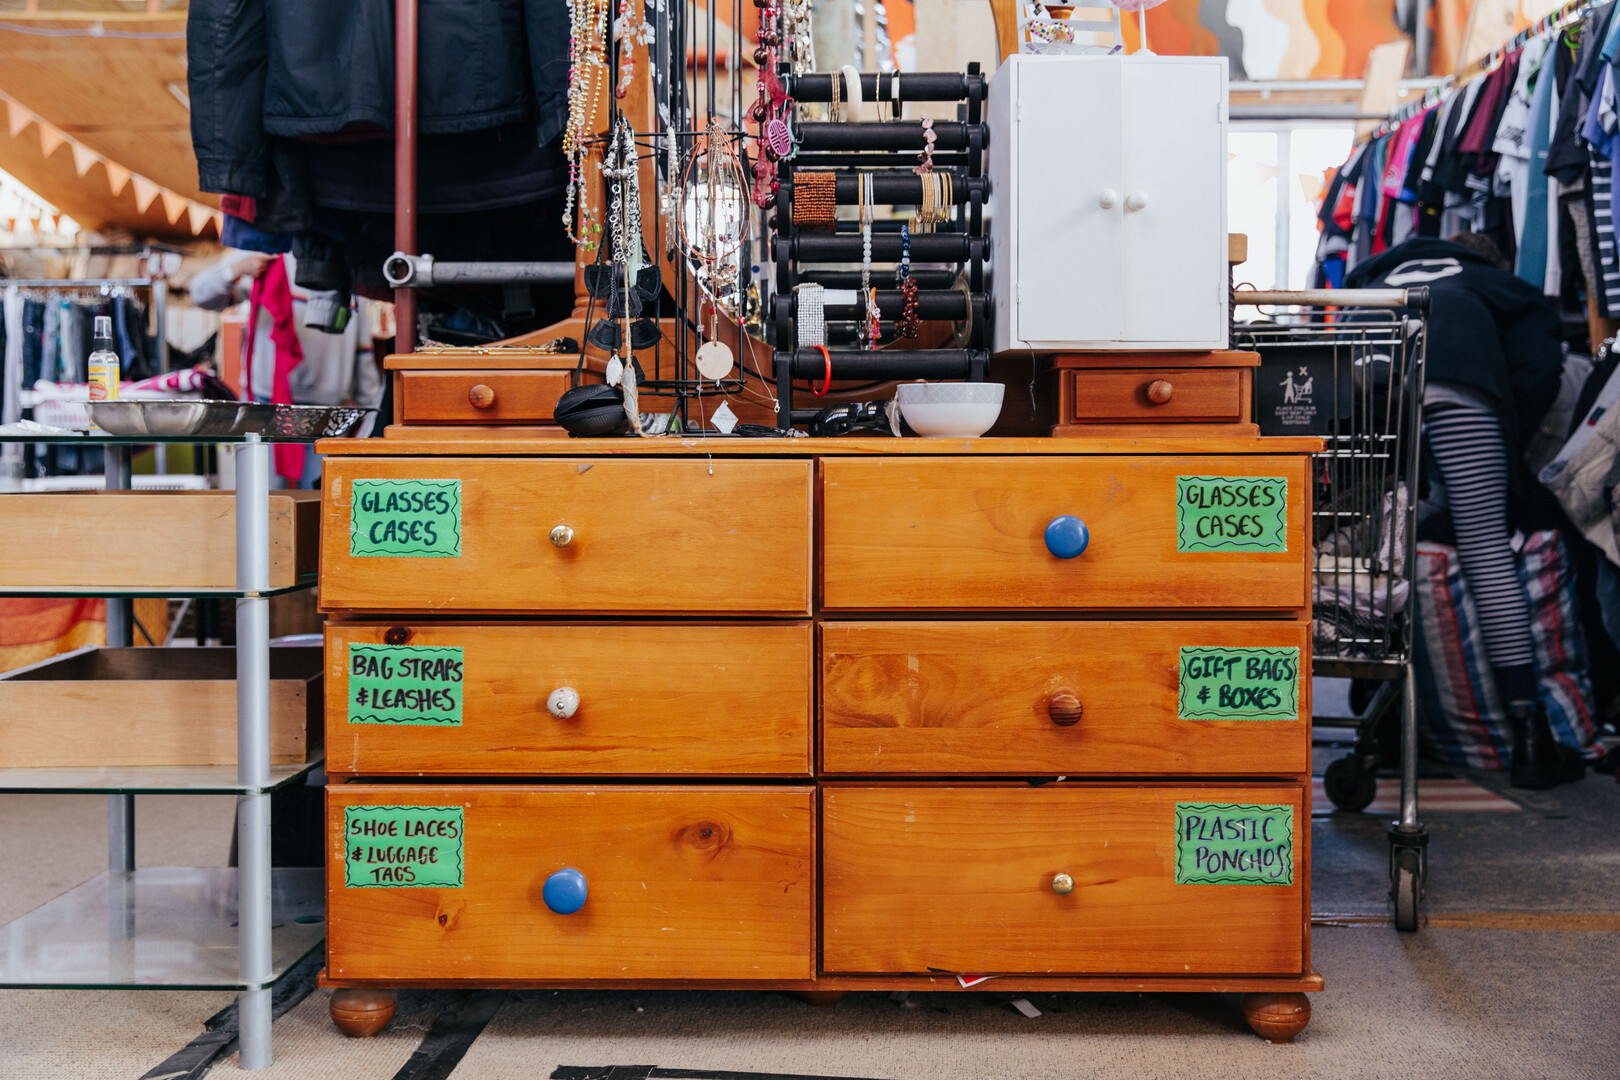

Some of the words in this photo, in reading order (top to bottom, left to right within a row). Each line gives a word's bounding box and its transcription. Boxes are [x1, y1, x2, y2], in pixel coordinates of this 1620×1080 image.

[361, 491, 450, 515] GLASSES
[1186, 485, 1275, 509] GLASSES
[369, 520, 437, 546] CASES
[1196, 514, 1264, 538] CASES
[352, 655, 394, 680] BAG
[397, 658, 463, 682] STRAPS
[1187, 655, 1242, 680] GIFT
[1246, 657, 1293, 681] BAGS
[371, 688, 456, 712] LEASHES
[1218, 684, 1281, 710] BOXES
[350, 818, 398, 837] SHOE
[404, 819, 458, 839] LACES
[1185, 815, 1275, 842] PLASTIC
[366, 845, 439, 865] LUGGAGE
[1195, 844, 1286, 878] PONCHOS
[369, 865, 416, 883] TAGS
